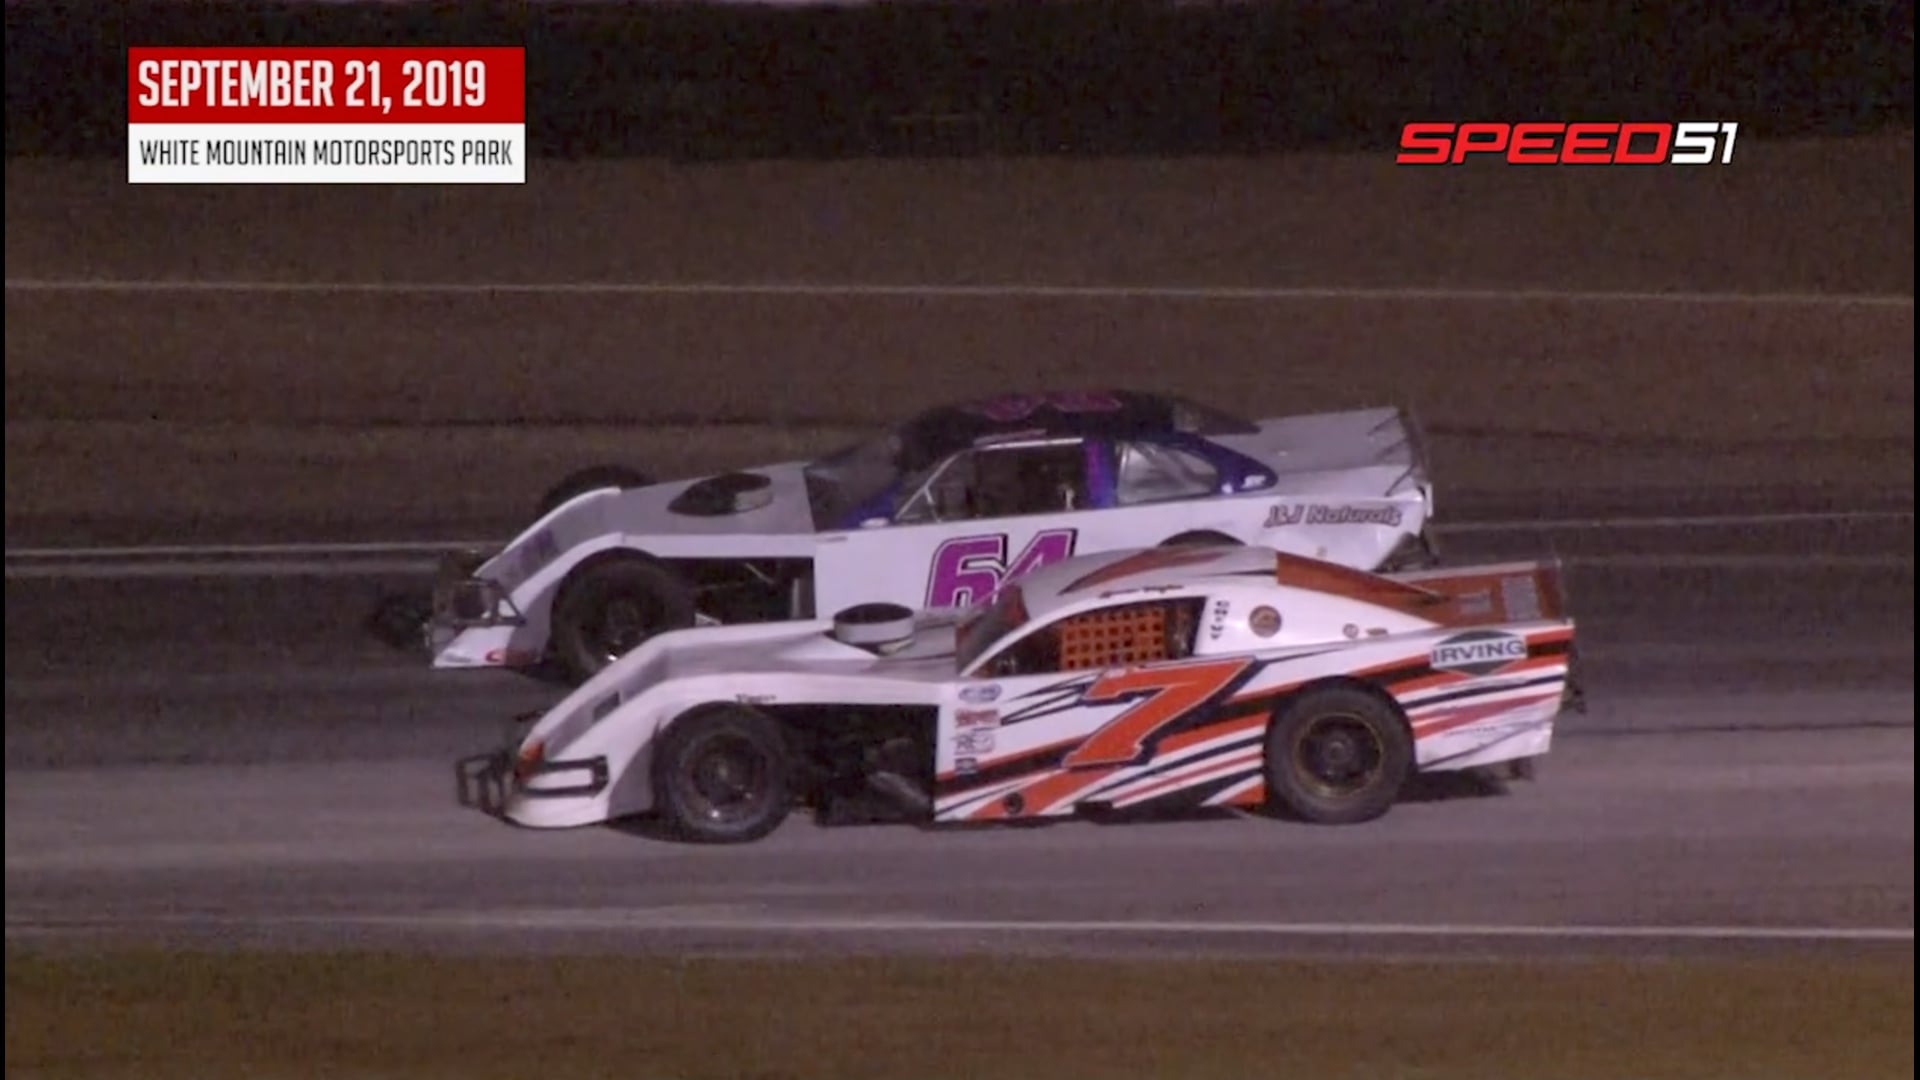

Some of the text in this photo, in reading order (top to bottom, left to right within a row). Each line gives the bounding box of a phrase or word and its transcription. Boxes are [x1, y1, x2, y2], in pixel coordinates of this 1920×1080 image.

[1305, 504, 1403, 527] Naturals
[1432, 640, 1527, 664] IRVING
[1060, 655, 1260, 769] 7
